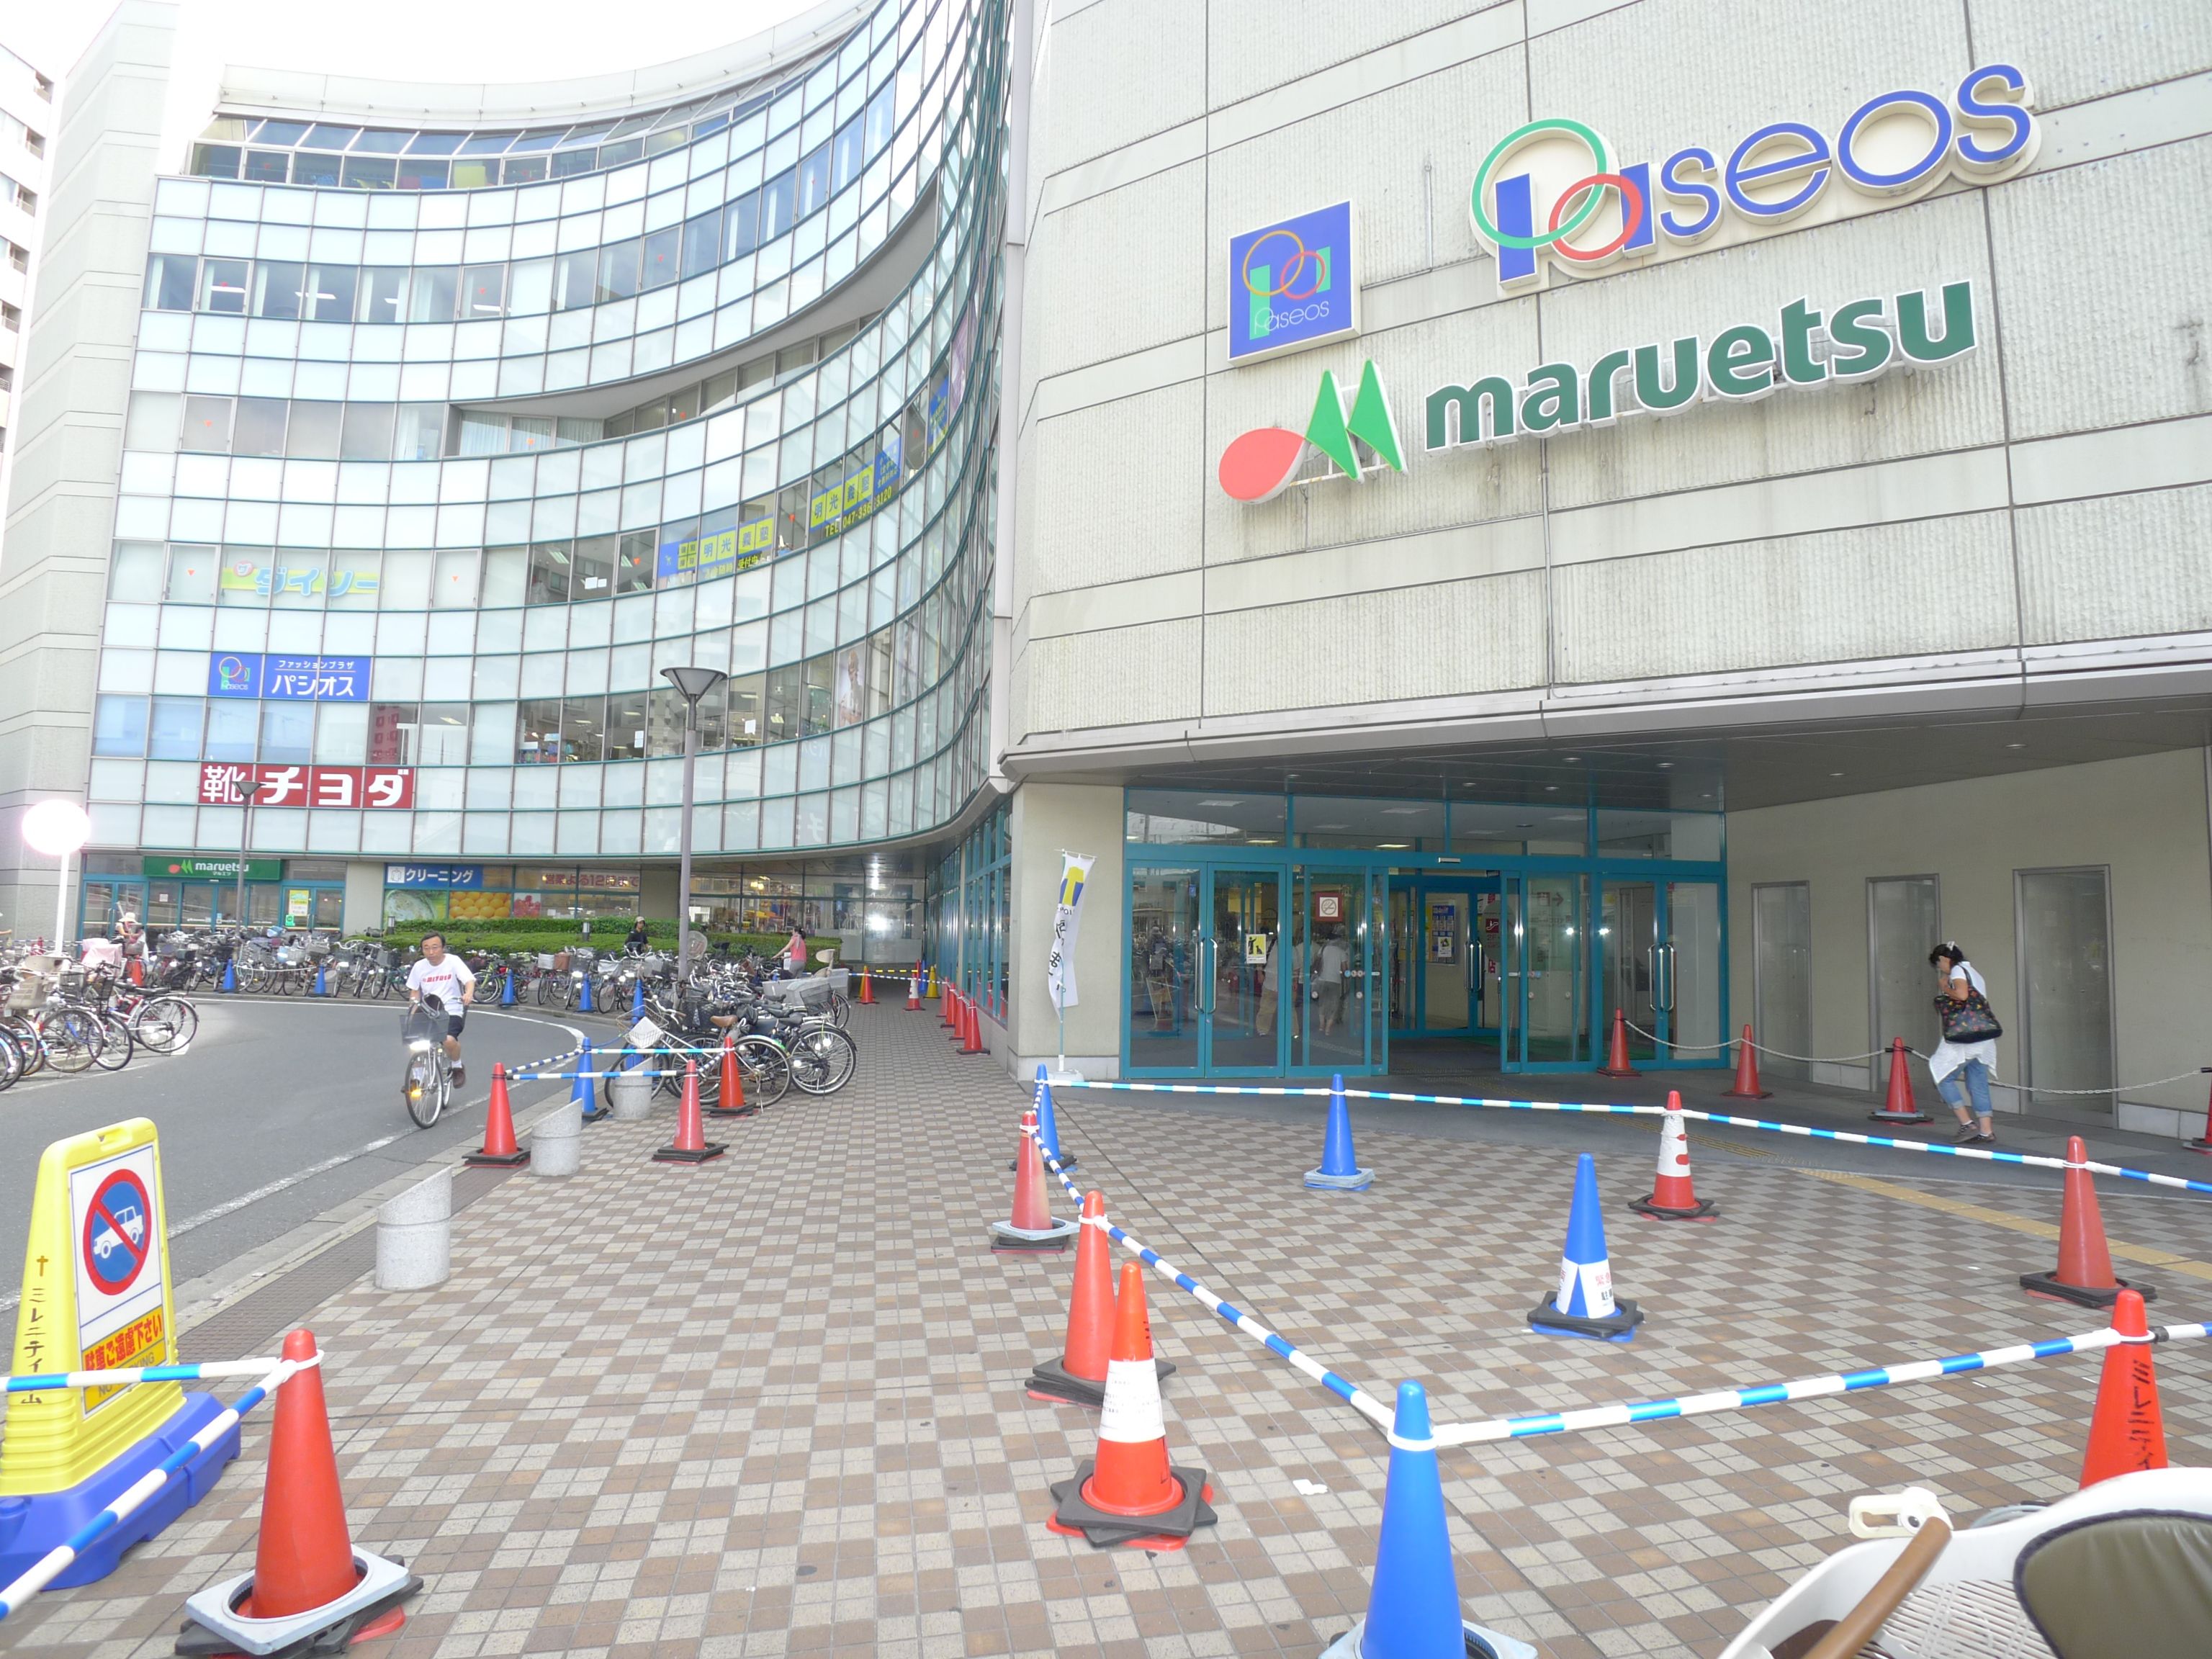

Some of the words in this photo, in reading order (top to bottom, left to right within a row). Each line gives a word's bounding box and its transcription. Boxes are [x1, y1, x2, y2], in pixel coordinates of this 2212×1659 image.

[1425, 279, 1979, 452] maruetsu
[271, 675, 354, 696] パシオス
[405, 868, 475, 884] クリーニング
